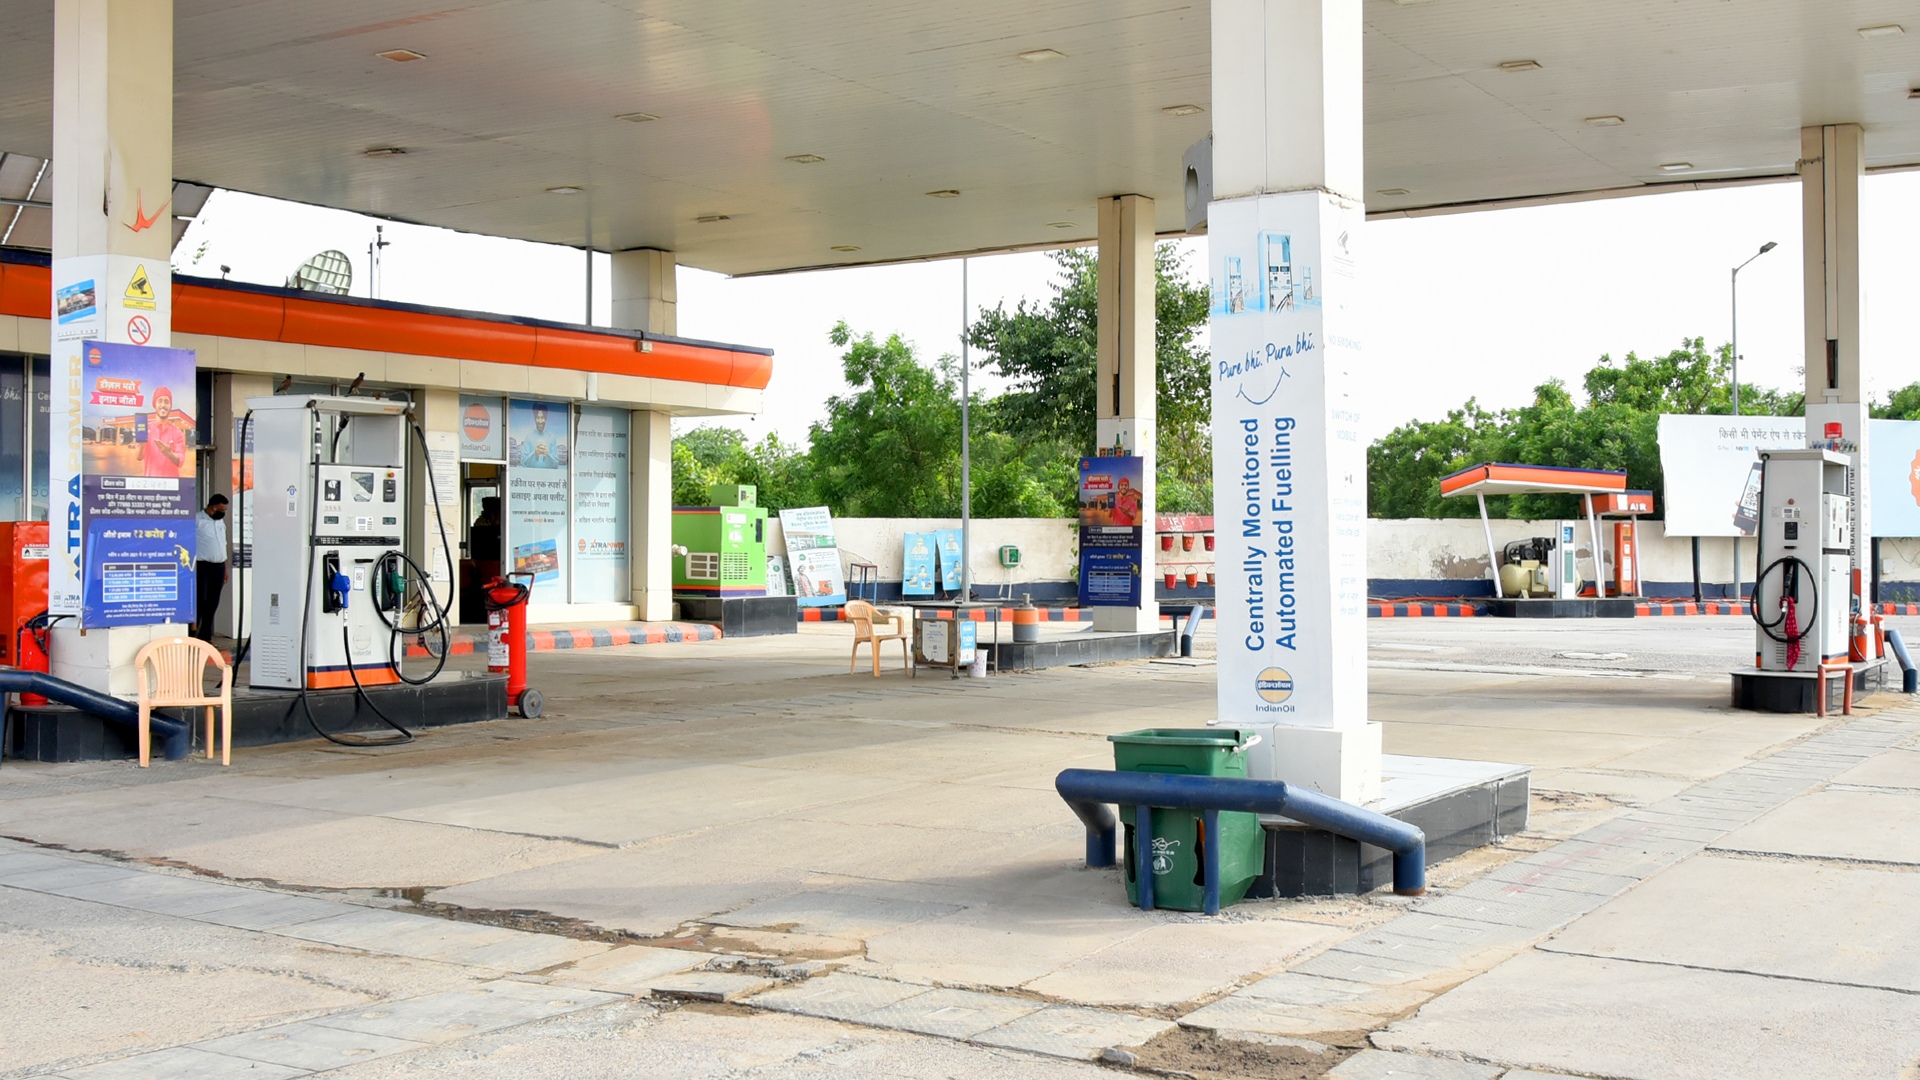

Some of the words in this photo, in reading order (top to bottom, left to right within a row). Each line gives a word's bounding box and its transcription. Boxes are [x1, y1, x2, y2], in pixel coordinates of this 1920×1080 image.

[1337, 335, 1362, 351] SMOKING
[1218, 361, 1242, 381] Pure
[1245, 350, 1263, 372] bhi.
[1266, 343, 1293, 363] Pura
[1296, 332, 1315, 354] bhi.
[122, 380, 136, 391] भरो
[98, 395, 117, 405] इनाम
[119, 395, 137, 405] जीतो
[1331, 409, 1353, 423] SWITCH
[1336, 430, 1357, 442] MOBILE
[1719, 427, 1738, 440] किसी
[1740, 427, 1749, 440] भी
[1782, 428, 1790, 440] से
[461, 443, 490, 452] IndianOil
[1270, 417, 1296, 511] Fuelling
[1240, 418, 1261, 537] Monitored
[1629, 503, 1647, 511] AIR
[1272, 520, 1297, 651] Automated
[1243, 546, 1267, 651] Centrally
[1255, 704, 1295, 713] IndianOil
